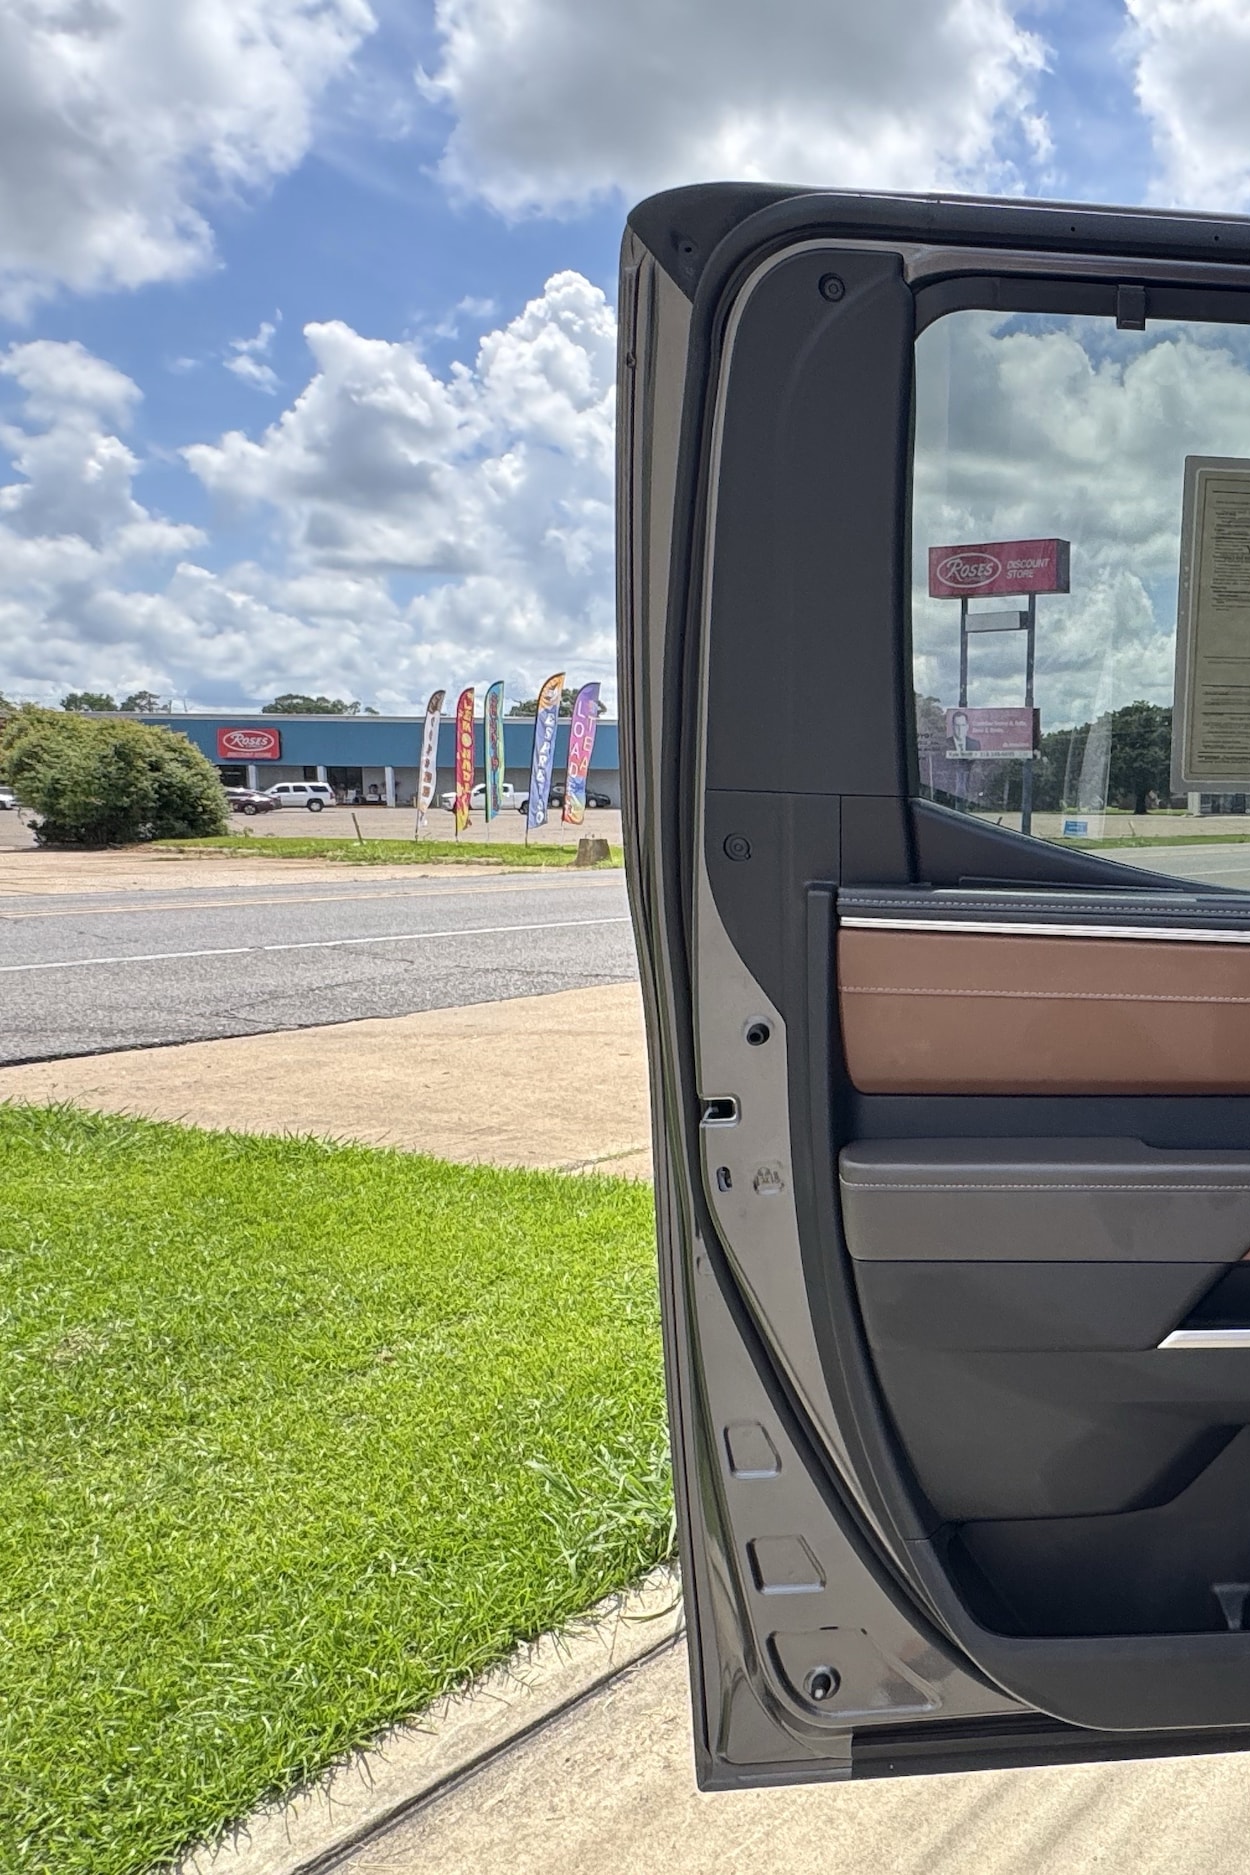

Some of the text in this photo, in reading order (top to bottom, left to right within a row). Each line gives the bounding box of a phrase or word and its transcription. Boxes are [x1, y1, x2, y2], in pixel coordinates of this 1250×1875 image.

[945, 559, 993, 581] ROSES
[1006, 558, 1051, 570] DISCOUNT
[1006, 570, 1034, 580] STORE
[230, 733, 268, 748] ROSES
[579, 716, 598, 770] TEA
